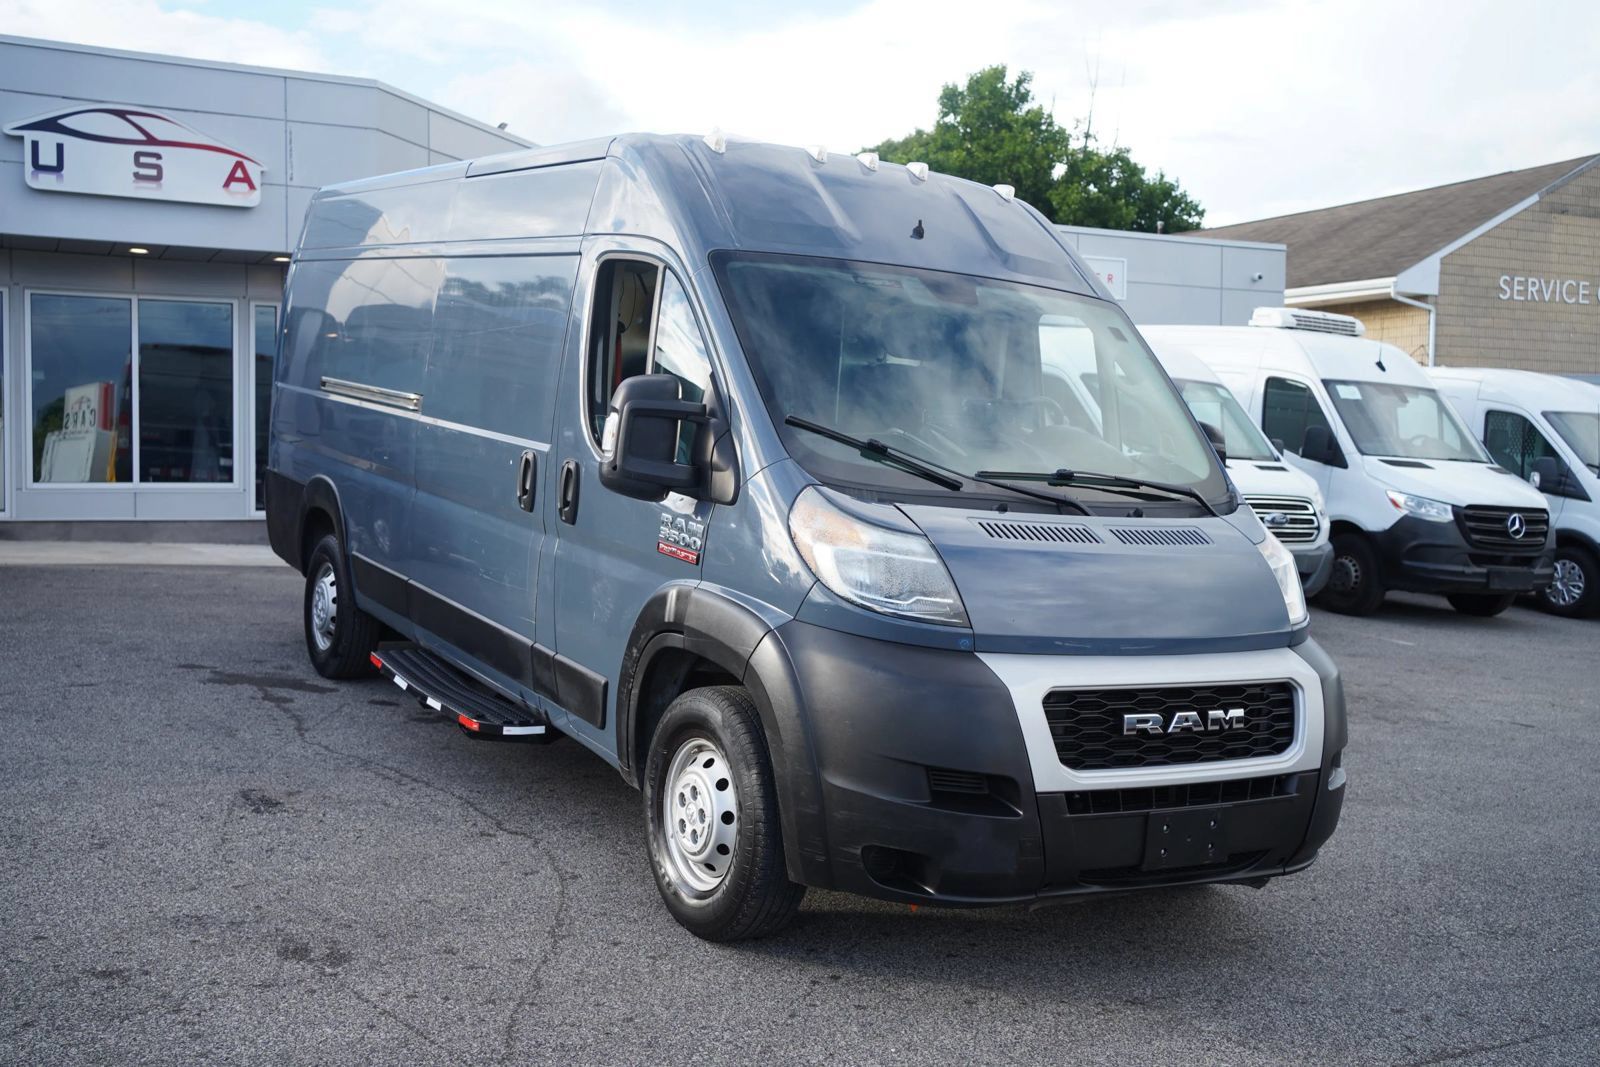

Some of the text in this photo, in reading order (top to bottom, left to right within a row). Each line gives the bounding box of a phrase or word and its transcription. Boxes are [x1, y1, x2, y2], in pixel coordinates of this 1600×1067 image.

[1499, 275, 1590, 304] SERVICE
[660, 512, 705, 538] RAM
[1123, 708, 1245, 736] RAM
